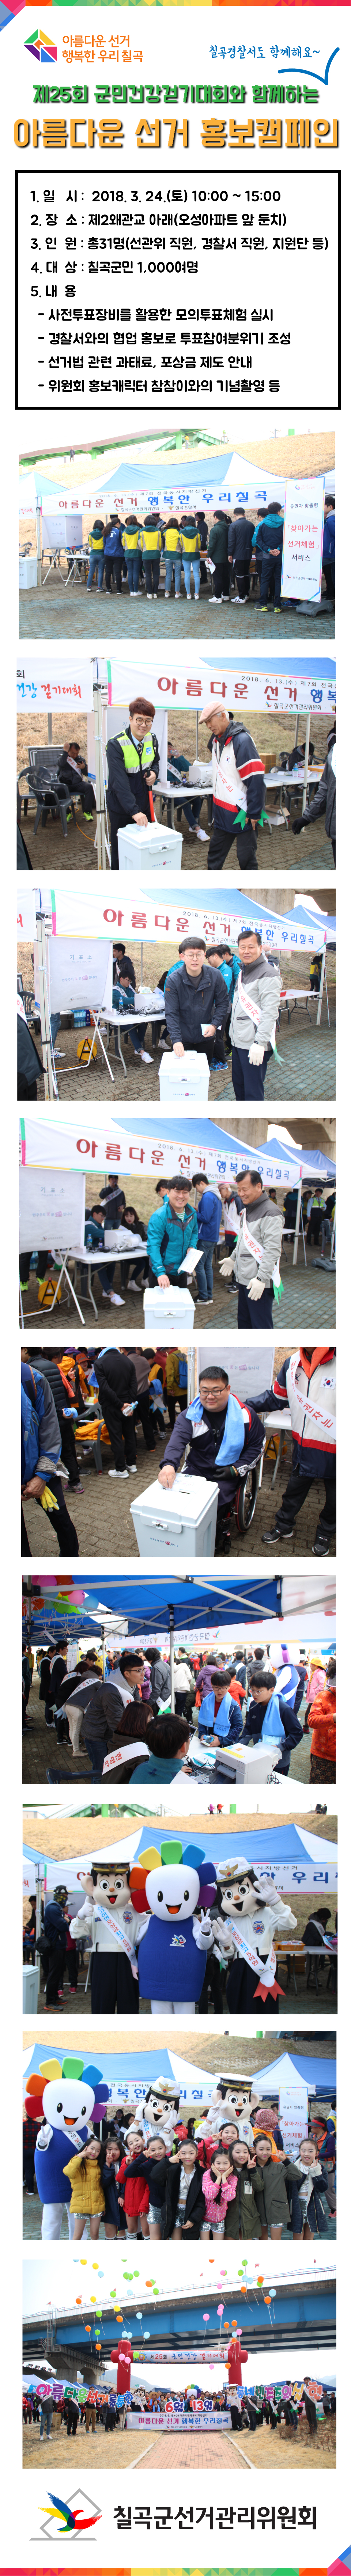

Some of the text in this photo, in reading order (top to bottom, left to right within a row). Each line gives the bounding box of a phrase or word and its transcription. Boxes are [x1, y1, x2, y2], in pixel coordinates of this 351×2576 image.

[59, 499, 104, 509] 아름다운
[113, 497, 137, 507] 선거
[148, 495, 190, 506] 행복한
[41, 683, 82, 699] 걷기대회
[157, 677, 297, 702] 아름다운 선거
[274, 703, 322, 711] 칠곡군선거관리위원회
[103, 909, 189, 932] 아름다운
[203, 921, 231, 937] 선거
[249, 921, 285, 930] 전국동시지방선거
[76, 1138, 165, 1166] 아름다운
[178, 1154, 206, 1171] 선거
[158, 1143, 176, 1151] 2018.
[224, 1155, 261, 1164] 전국동시지방선거
[297, 1395, 333, 1428] 유권자는
[165, 2400, 212, 2412] 6월 13일
